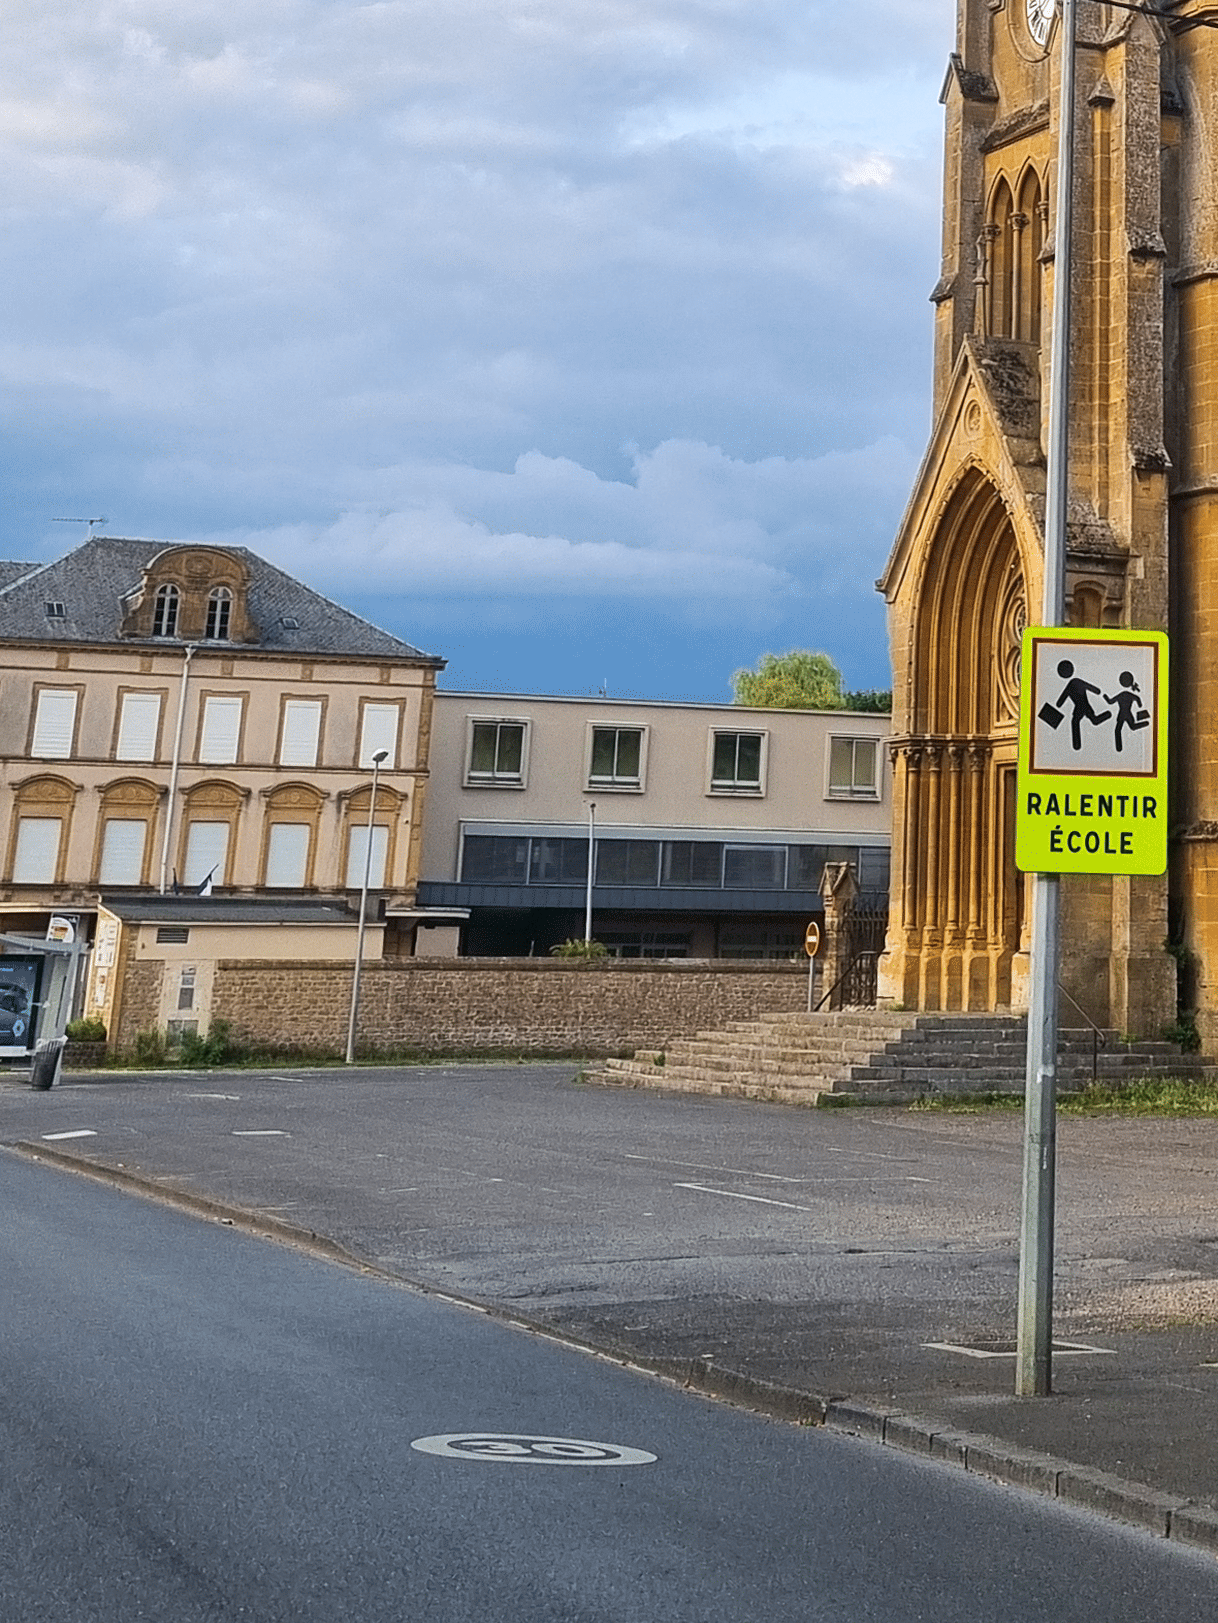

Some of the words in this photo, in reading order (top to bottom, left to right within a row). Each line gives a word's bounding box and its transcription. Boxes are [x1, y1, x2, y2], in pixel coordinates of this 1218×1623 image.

[1026, 792, 1157, 819] RALENTIR
[1049, 825, 1134, 854] ÉCOLE
[460, 1441, 606, 1457] 30
